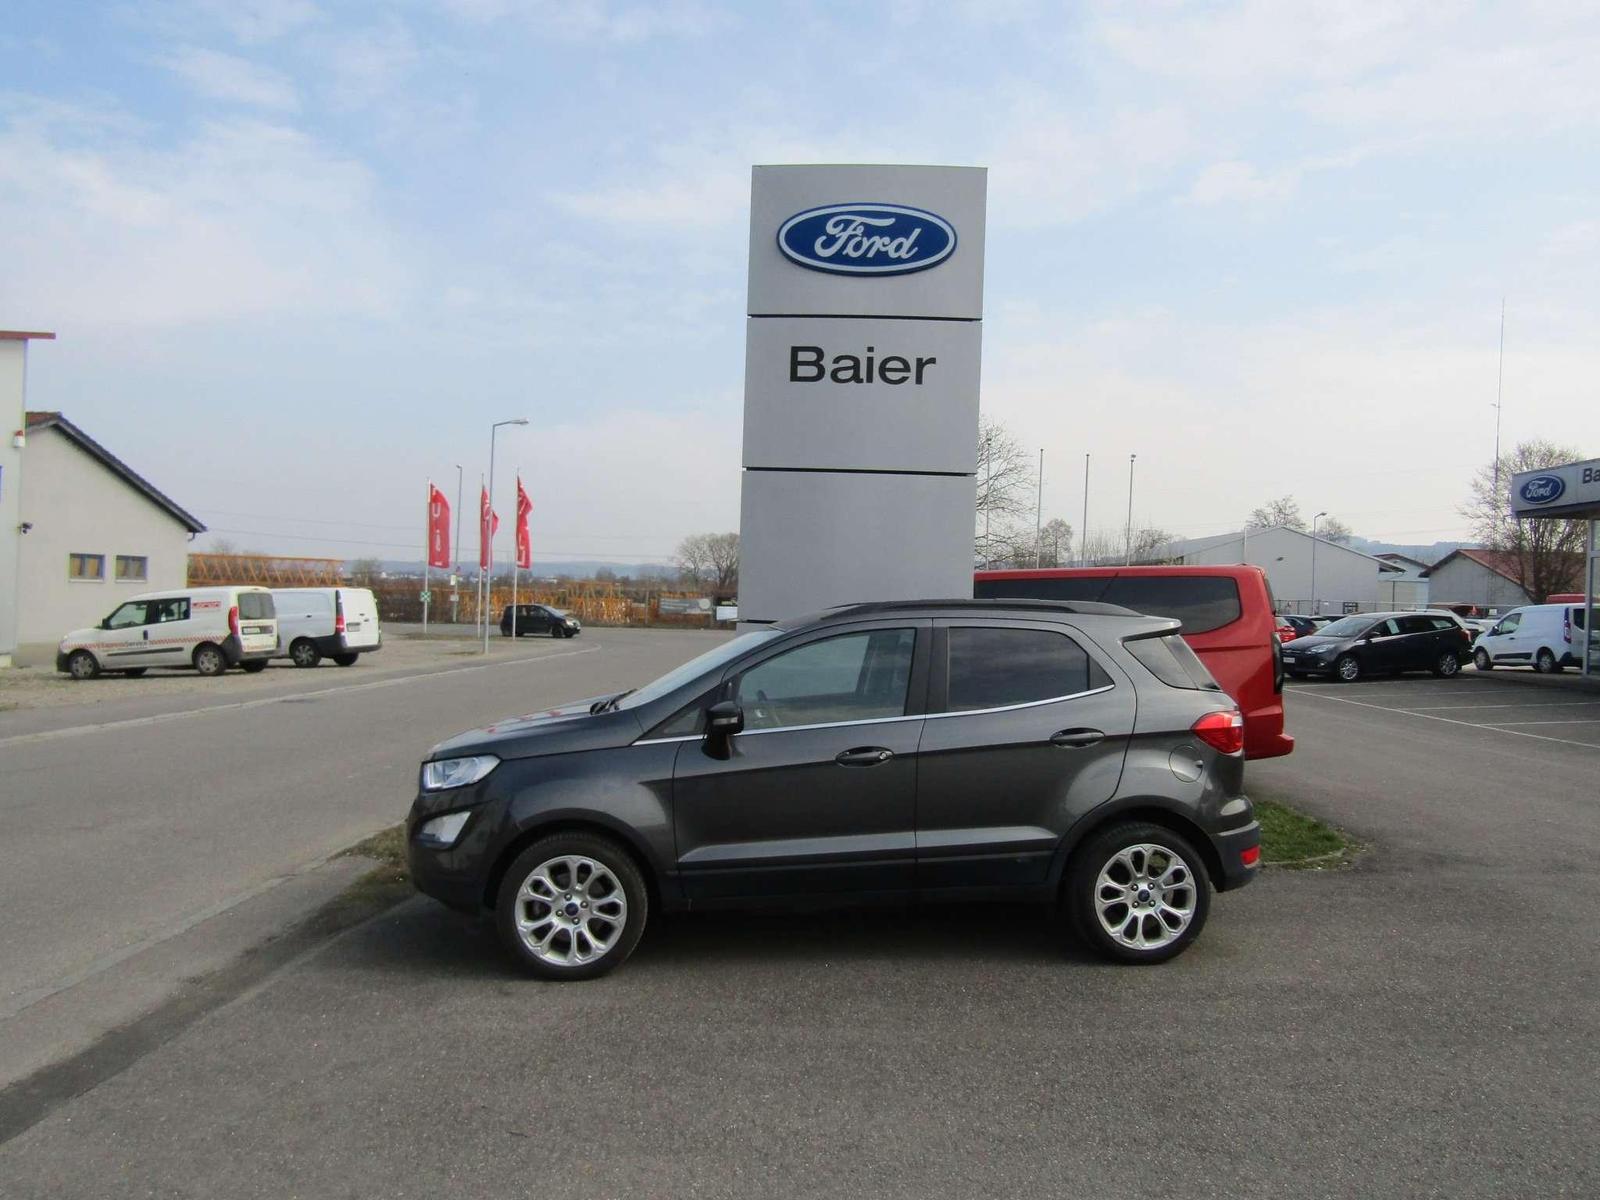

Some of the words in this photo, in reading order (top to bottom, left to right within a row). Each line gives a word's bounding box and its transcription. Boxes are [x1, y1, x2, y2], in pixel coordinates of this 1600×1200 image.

[814, 215, 922, 259] Ford
[790, 345, 936, 385] Baier
[1526, 479, 1554, 498] Ford
